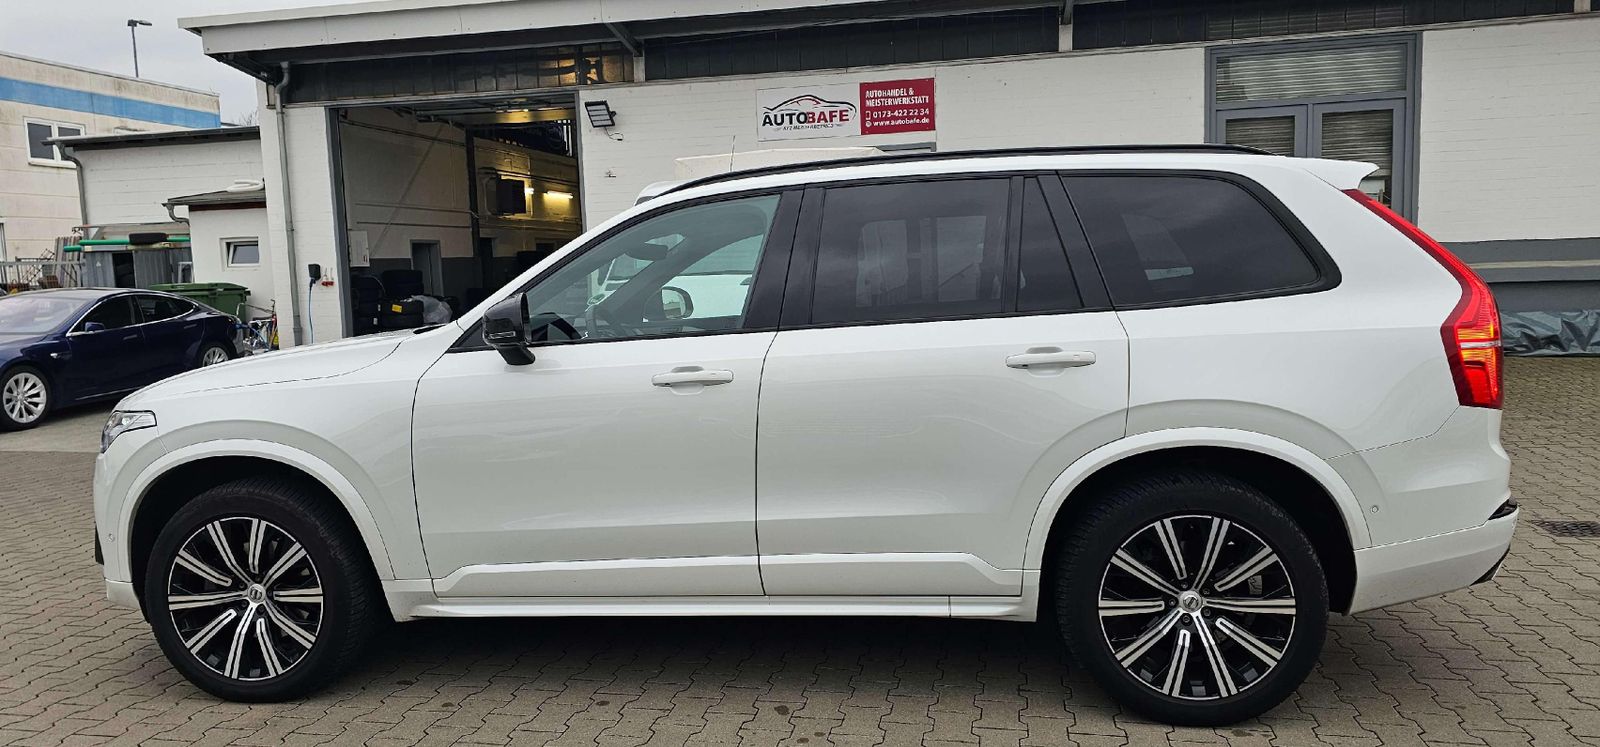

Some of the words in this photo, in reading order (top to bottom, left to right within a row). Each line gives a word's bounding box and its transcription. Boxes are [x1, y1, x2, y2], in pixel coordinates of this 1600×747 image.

[865, 88, 907, 98] AUTOHANDEL
[908, 87, 914, 95] &
[865, 96, 929, 107] MEISTERWERKSTATT
[762, 109, 849, 127] AUTOBAFE
[873, 109, 907, 118] 0173-422
[920, 108, 929, 116] 34
[873, 117, 929, 127] www.autobafe.de
